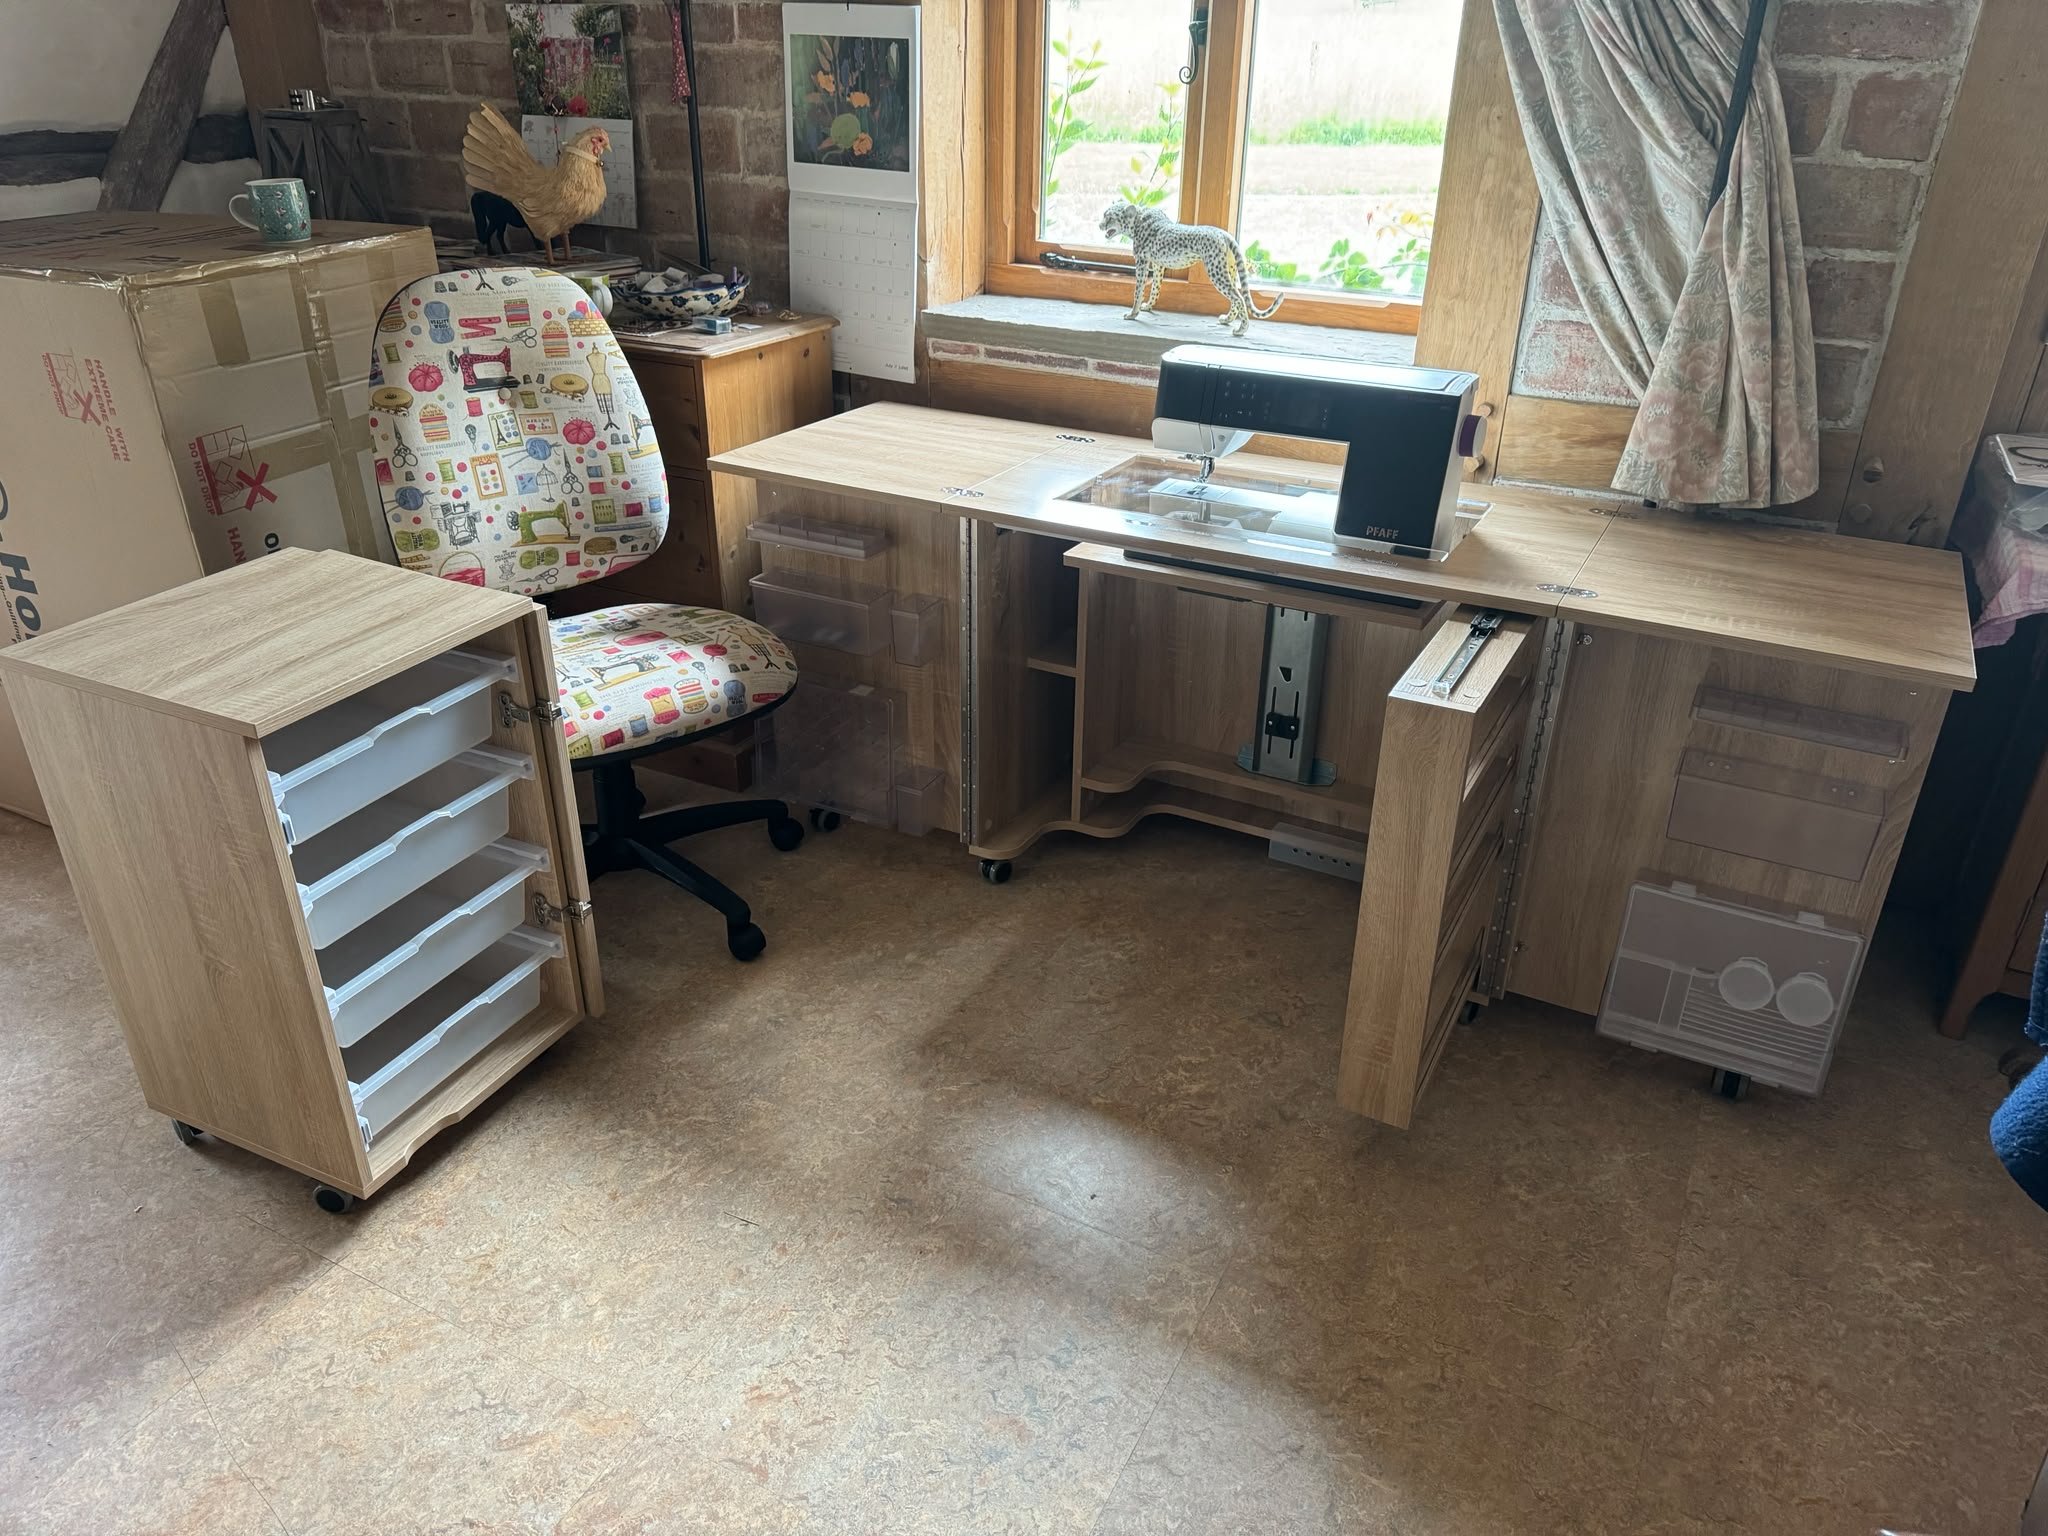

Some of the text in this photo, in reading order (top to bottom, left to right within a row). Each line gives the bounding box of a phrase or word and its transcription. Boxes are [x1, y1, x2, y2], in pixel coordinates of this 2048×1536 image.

[85, 358, 121, 461] EXTREME CARE
[94, 359, 131, 462] HANDLE WITH
[189, 442, 216, 515] DO NOT DROP
[228, 527, 247, 564] HAN
[1366, 525, 1399, 539] PFAFF
[0, 552, 41, 641] HO
